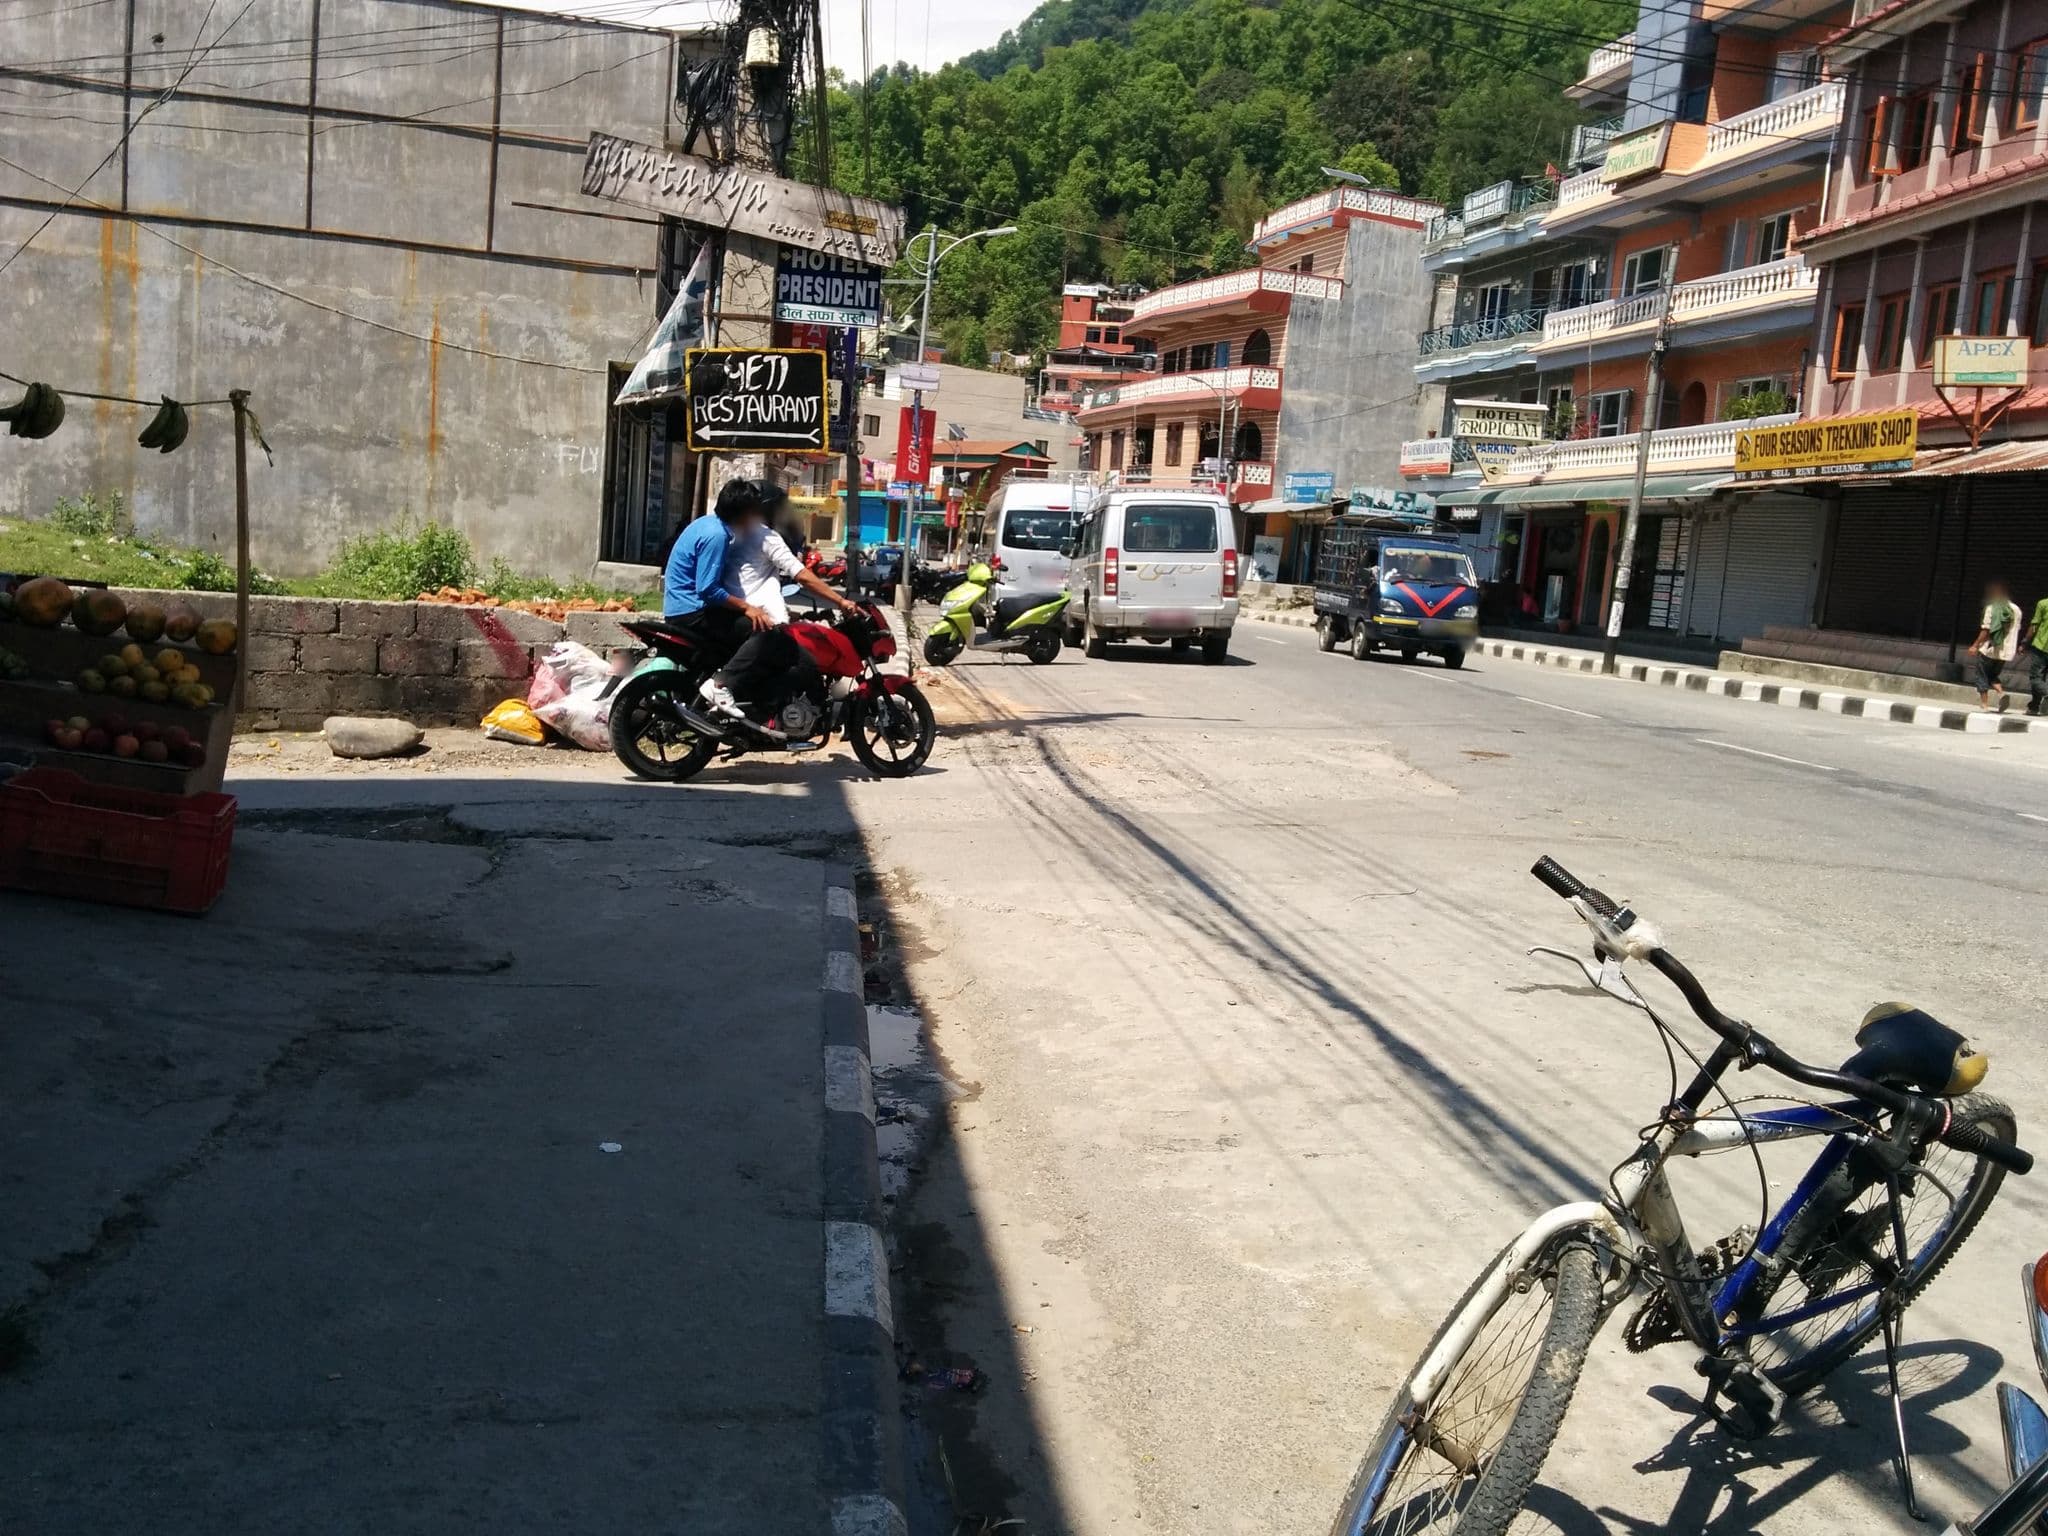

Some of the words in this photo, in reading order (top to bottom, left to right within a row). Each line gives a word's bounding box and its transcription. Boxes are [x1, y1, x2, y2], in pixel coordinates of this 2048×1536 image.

[767, 222, 816, 242] resort
[791, 248, 869, 275] HOTEL
[778, 273, 879, 308] PRESIDENT
[807, 309, 834, 321] सफा
[1958, 339, 2017, 356] APEX
[723, 353, 789, 393] YETI
[693, 394, 821, 424] RESTAURANT
[1476, 409, 1524, 422] HOTEL
[1460, 419, 1538, 438] TROPICANA
[1754, 432, 1778, 458] FOUR
[1779, 427, 1824, 455] SEASONS
[1825, 421, 1877, 452] TREKKING
[1880, 417, 1912, 447] SHOP
[1476, 442, 1517, 455] PARKING
[1751, 470, 1766, 479] BUY
[1771, 468, 1791, 477] SELL
[1795, 466, 1817, 476] RENT
